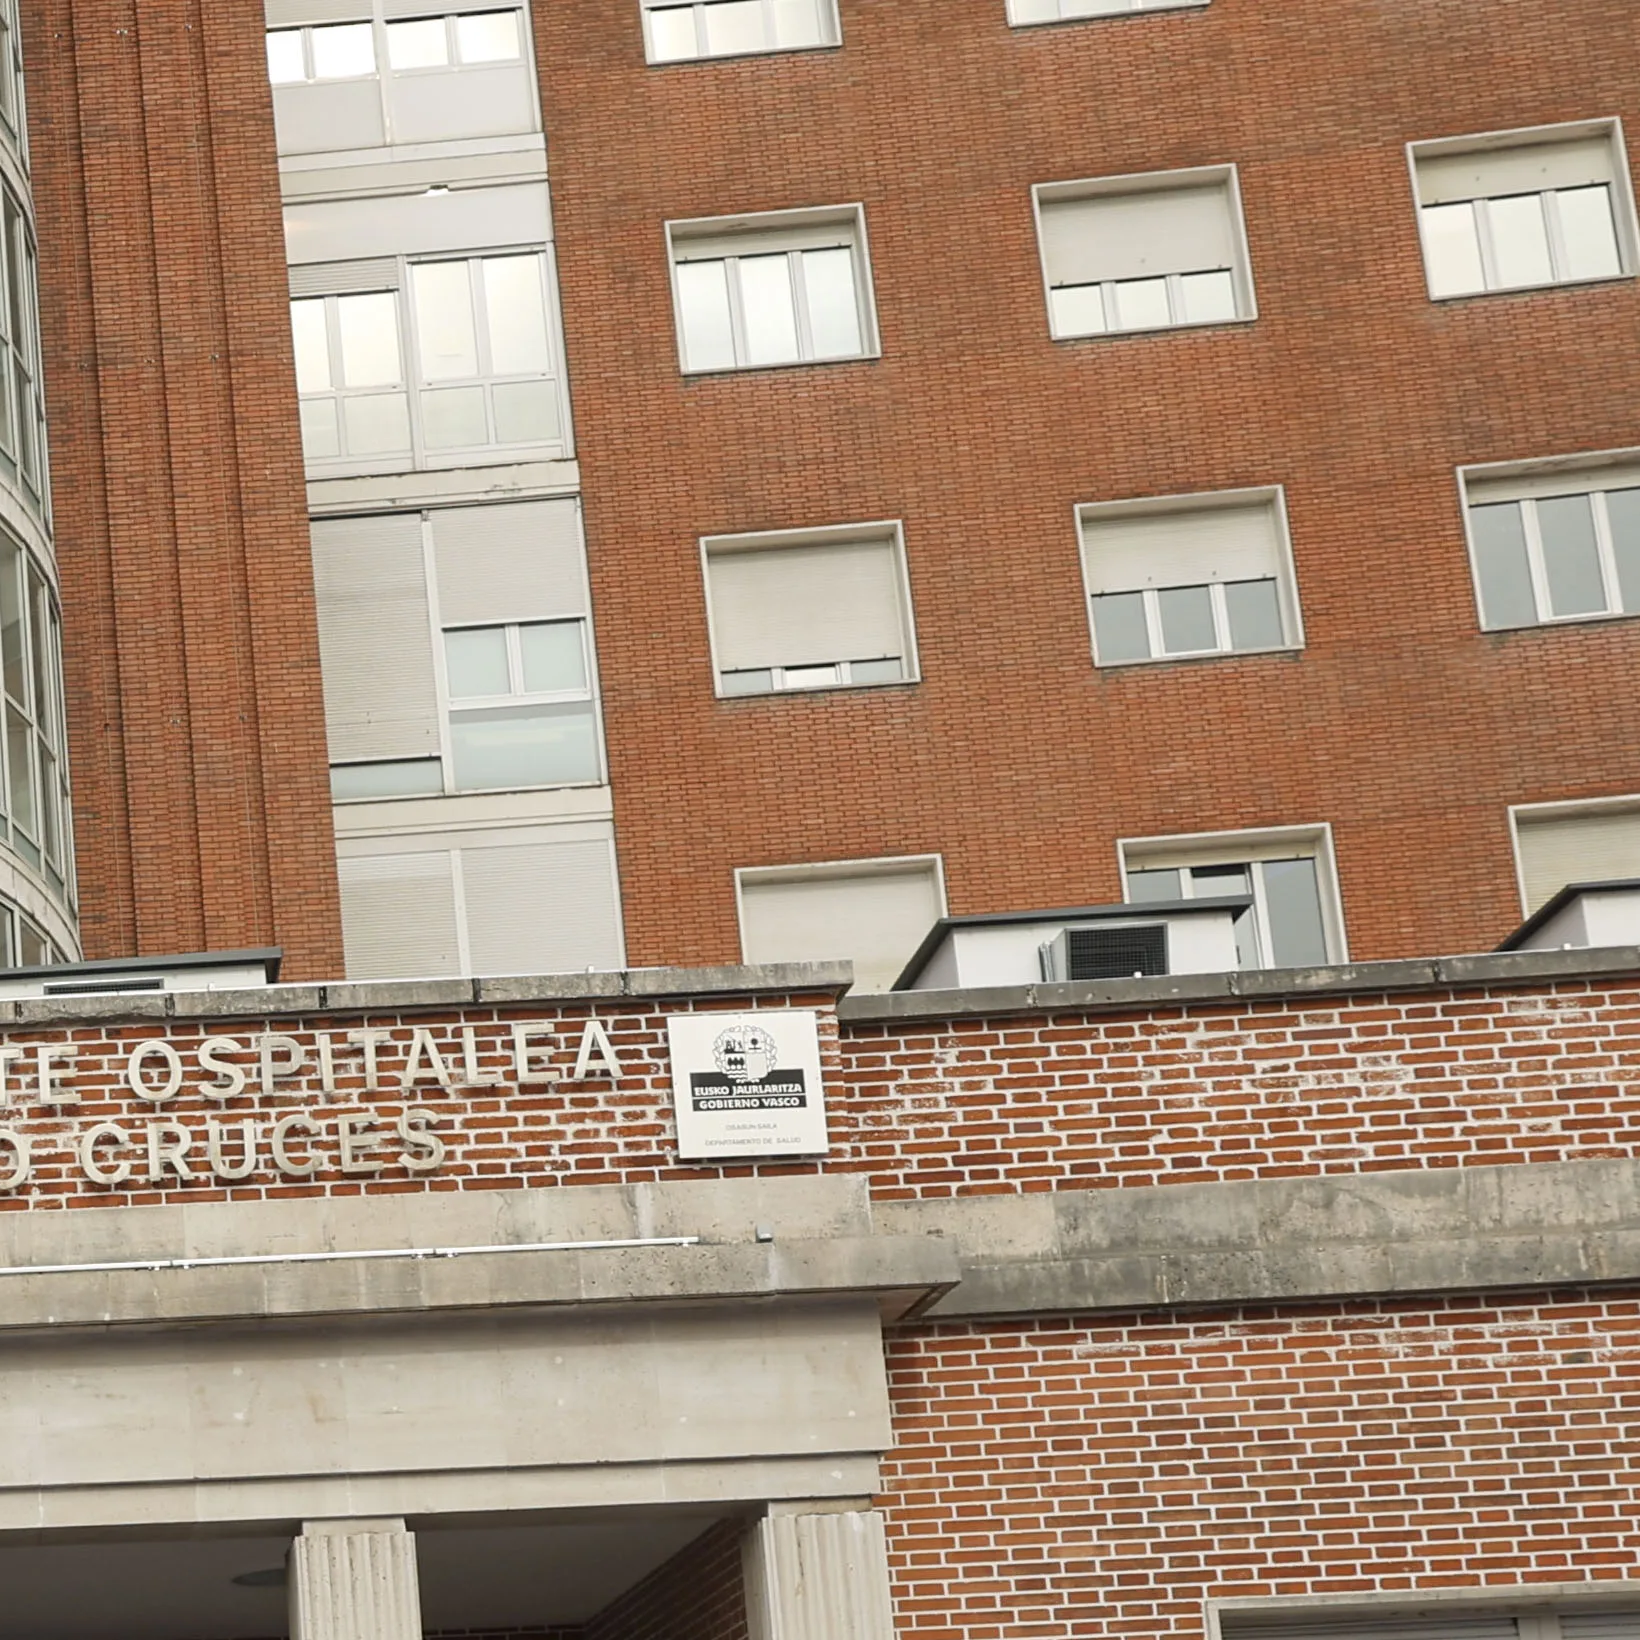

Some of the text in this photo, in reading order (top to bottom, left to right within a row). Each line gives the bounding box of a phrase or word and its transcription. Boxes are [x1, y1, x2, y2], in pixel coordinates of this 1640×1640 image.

[127, 1020, 624, 1101] OSPITALEA
[693, 1083, 803, 1097] EUSKO JAURLARITZA
[699, 1097, 800, 1110] GOBIERNO VASCO
[79, 1108, 446, 1186] CRUCES
